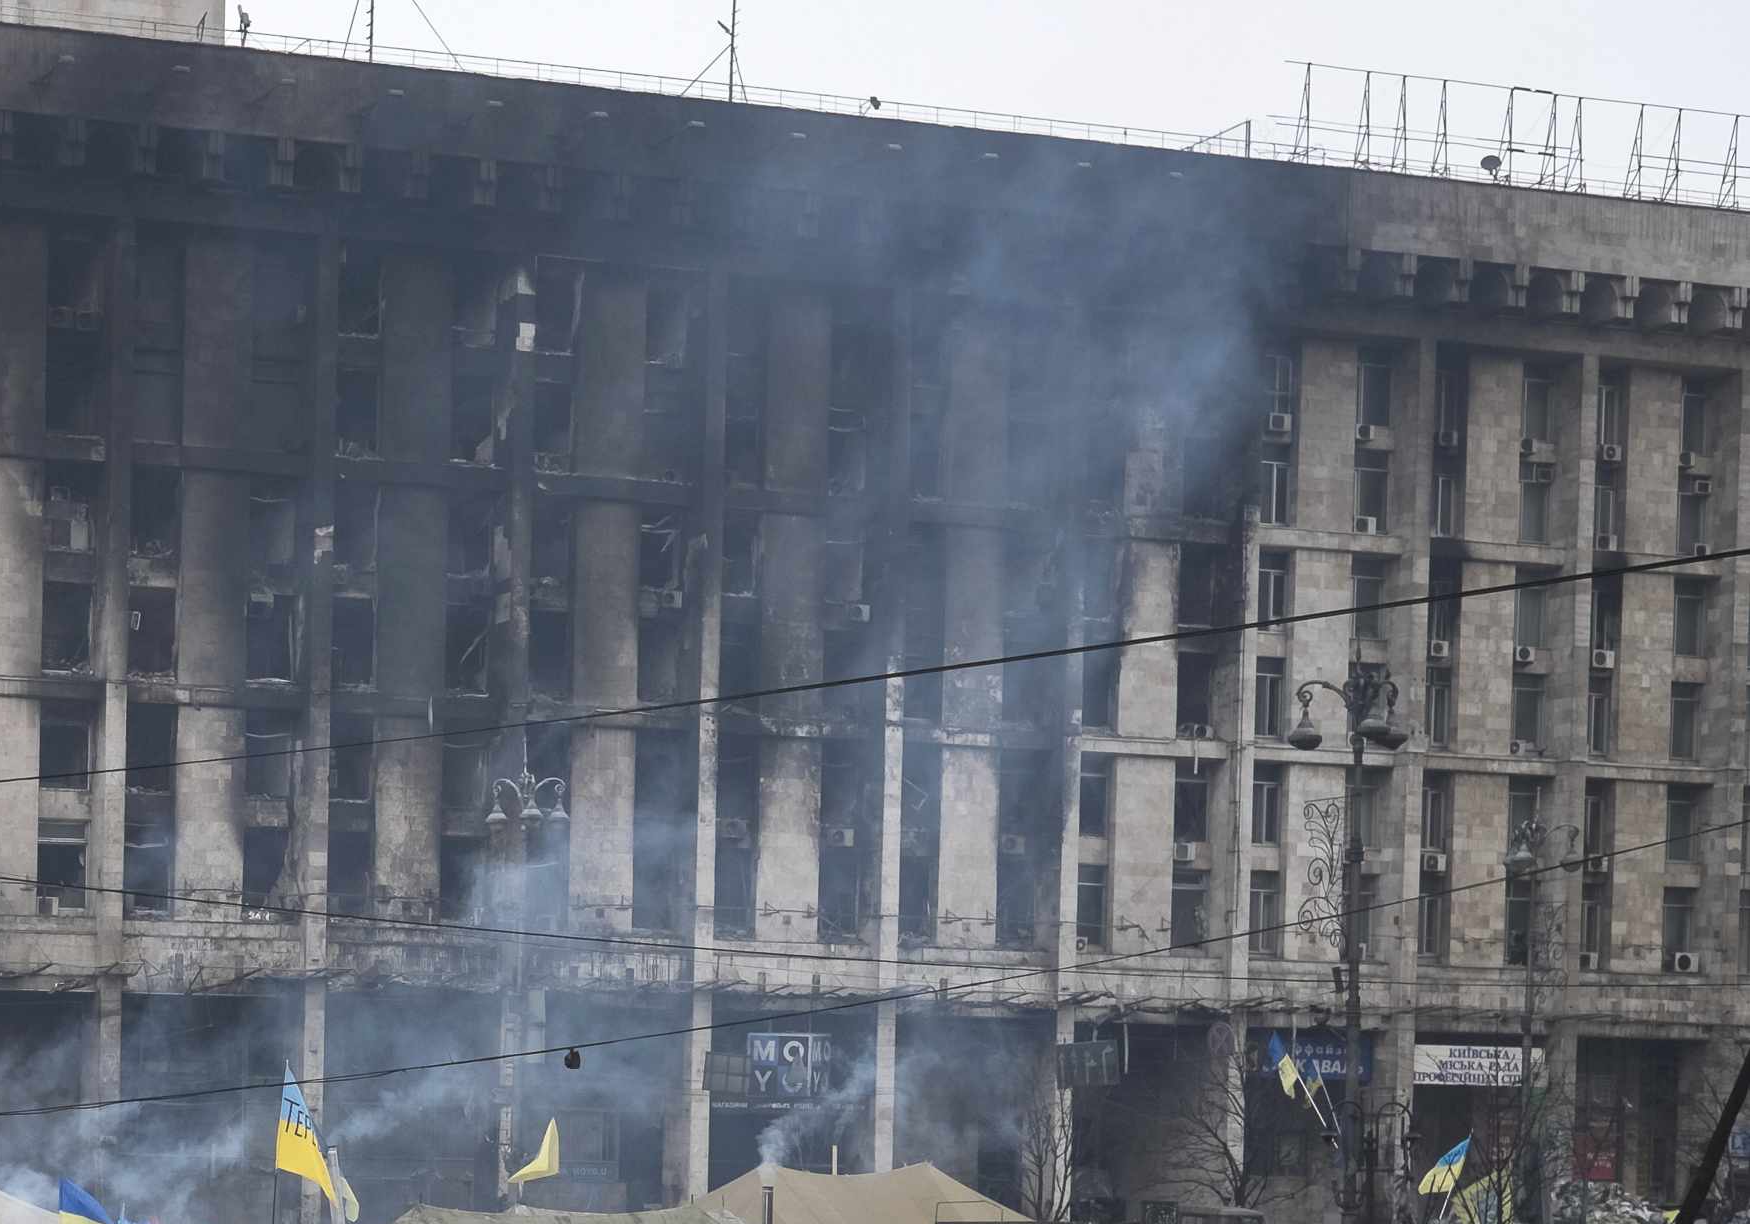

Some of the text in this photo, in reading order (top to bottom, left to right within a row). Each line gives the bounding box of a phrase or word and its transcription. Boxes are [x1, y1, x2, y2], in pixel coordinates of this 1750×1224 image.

[1449, 1047, 1510, 1059] КИЇВСЬКА
[1440, 1060, 1520, 1072] МІСЬКА РАДА
